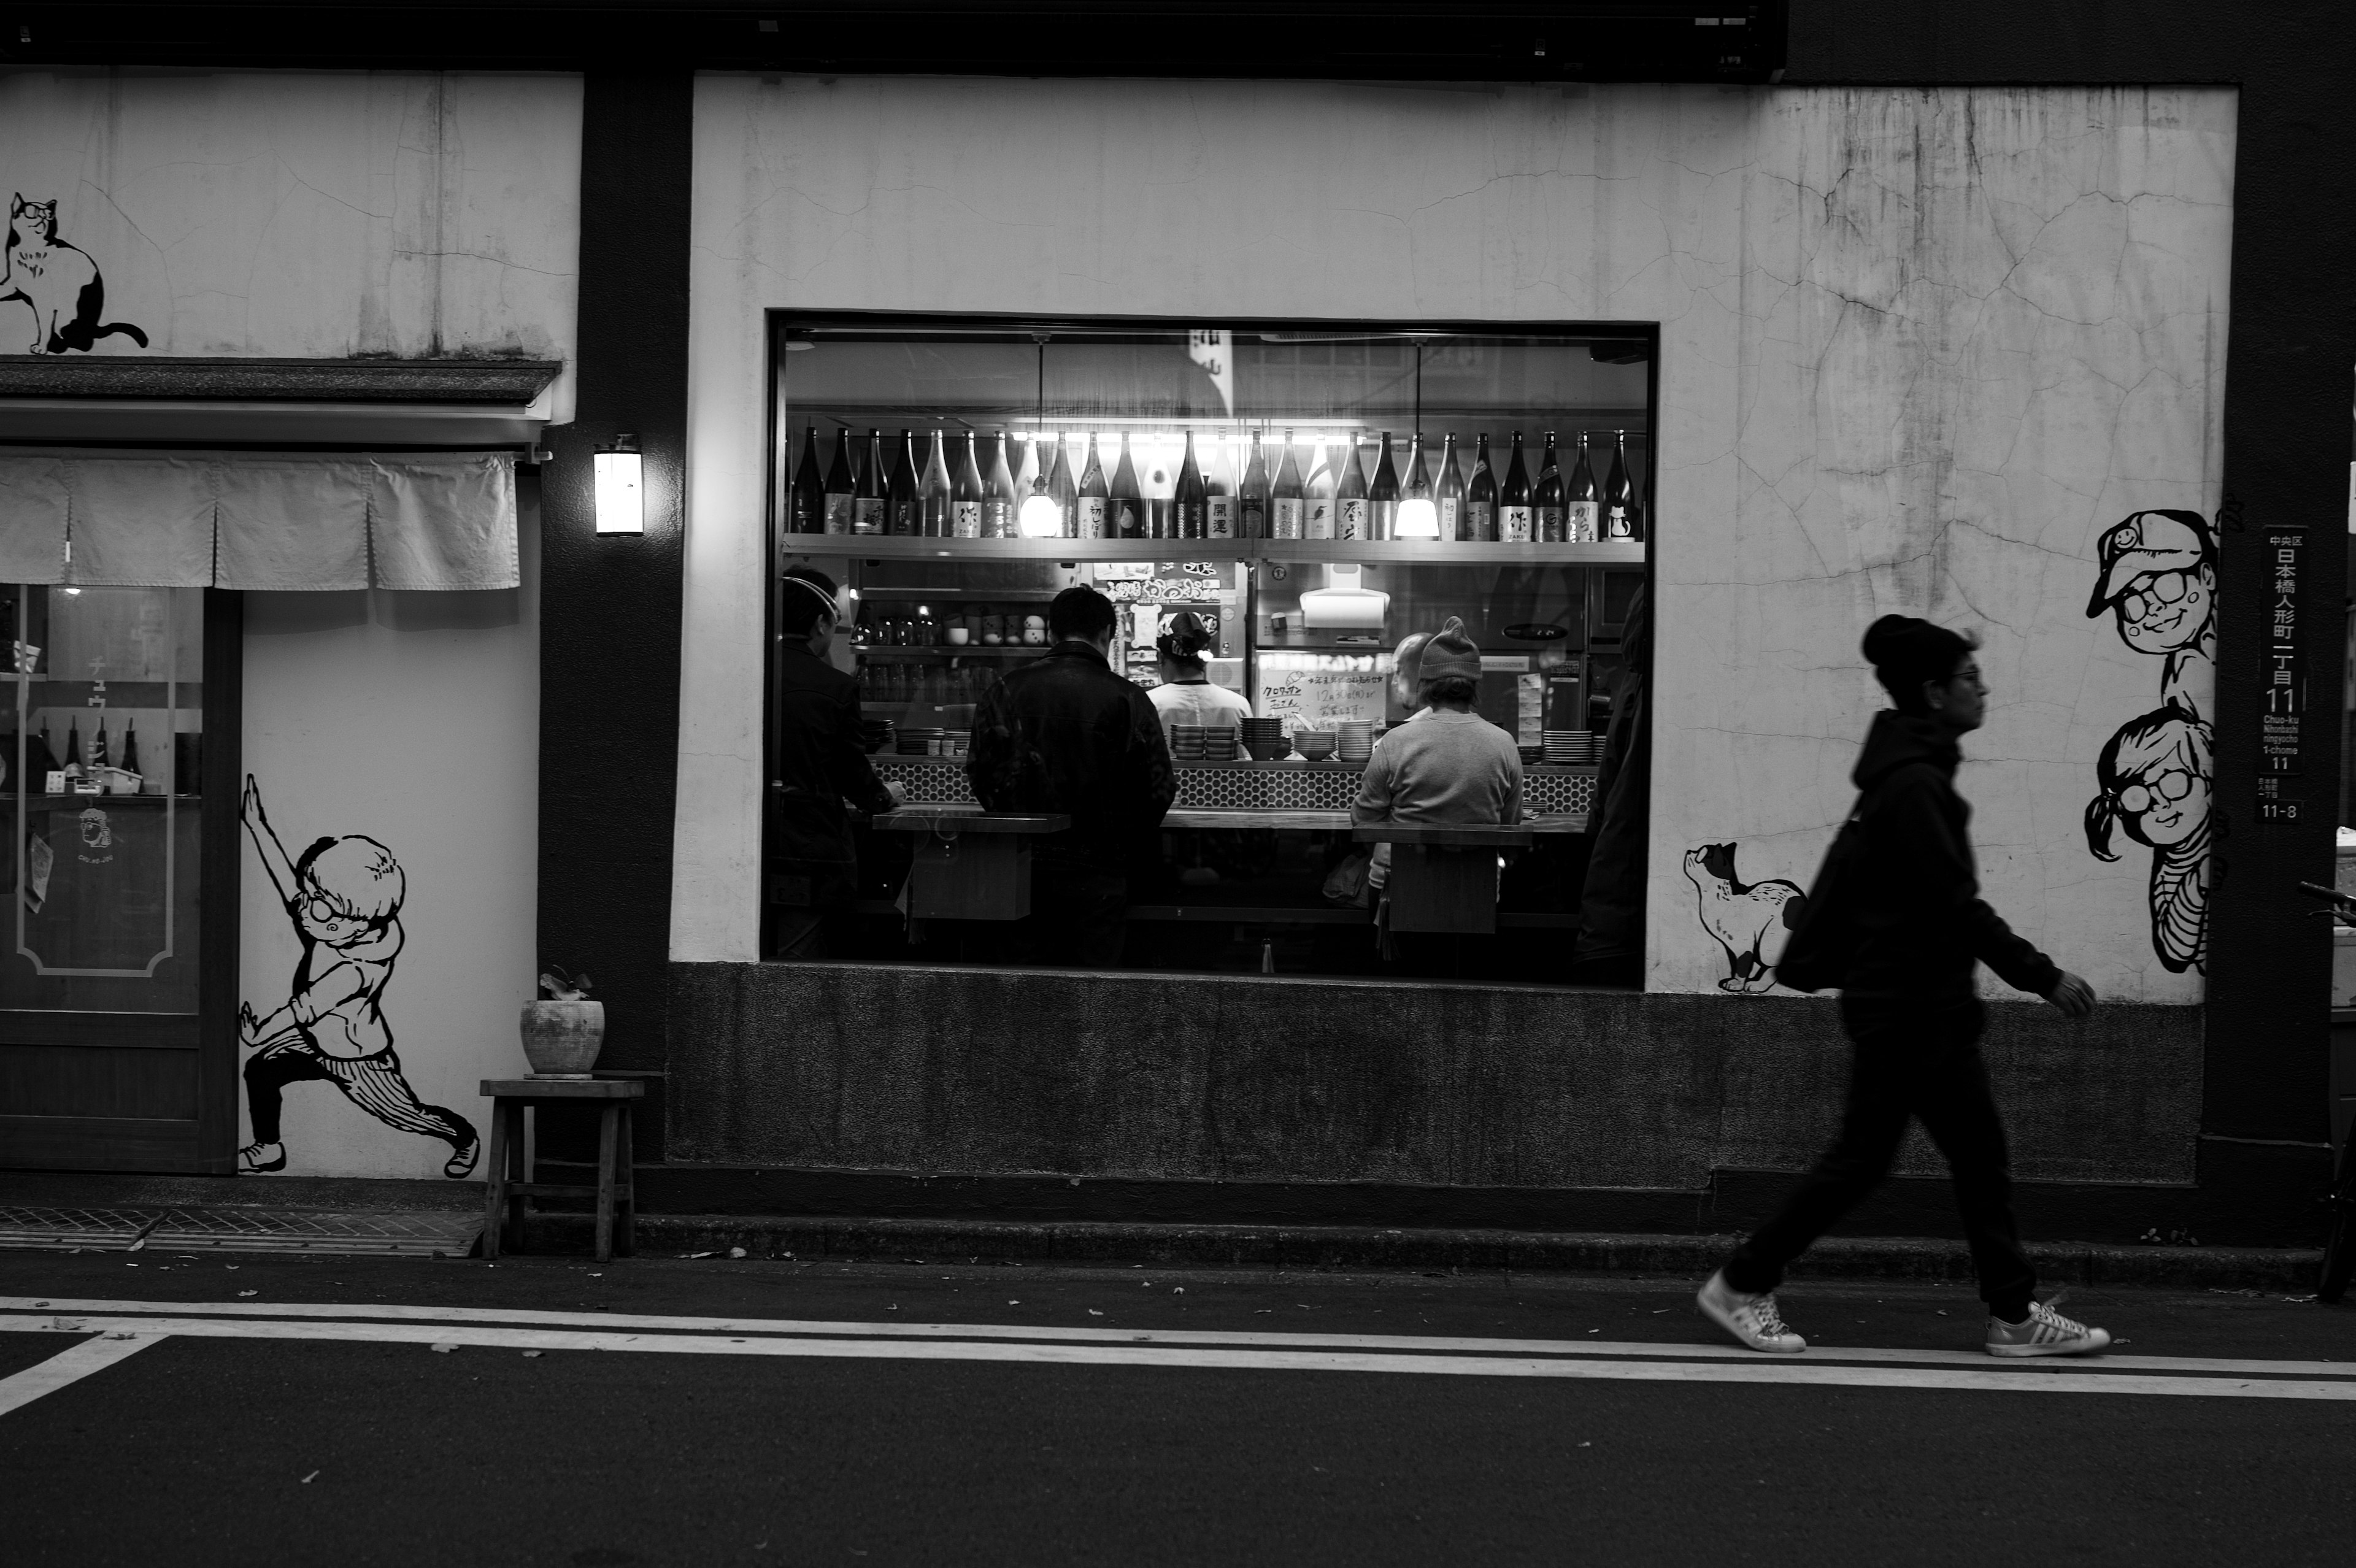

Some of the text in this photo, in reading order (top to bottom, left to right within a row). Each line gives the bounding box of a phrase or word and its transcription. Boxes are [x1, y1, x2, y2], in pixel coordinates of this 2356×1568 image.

[959, 507, 977, 526] 作
[1213, 504, 1228, 533] 開運
[1509, 512, 1526, 532] 作
[2270, 536, 2303, 546] 中央区
[2272, 548, 2296, 685] 日本橋人形町一丁目
[1263, 685, 1302, 696] クロワッサン
[1270, 699, 1298, 708] おでん
[2266, 688, 2293, 713] 11
[2263, 715, 2299, 724] Chuo-ku
[2263, 724, 2299, 734] Nihonbashi
[2263, 734, 2298, 744] ningyocho
[2263, 745, 2298, 755] 1-chome
[2272, 756, 2288, 769] 11
[2262, 805, 2297, 818] 11-8
